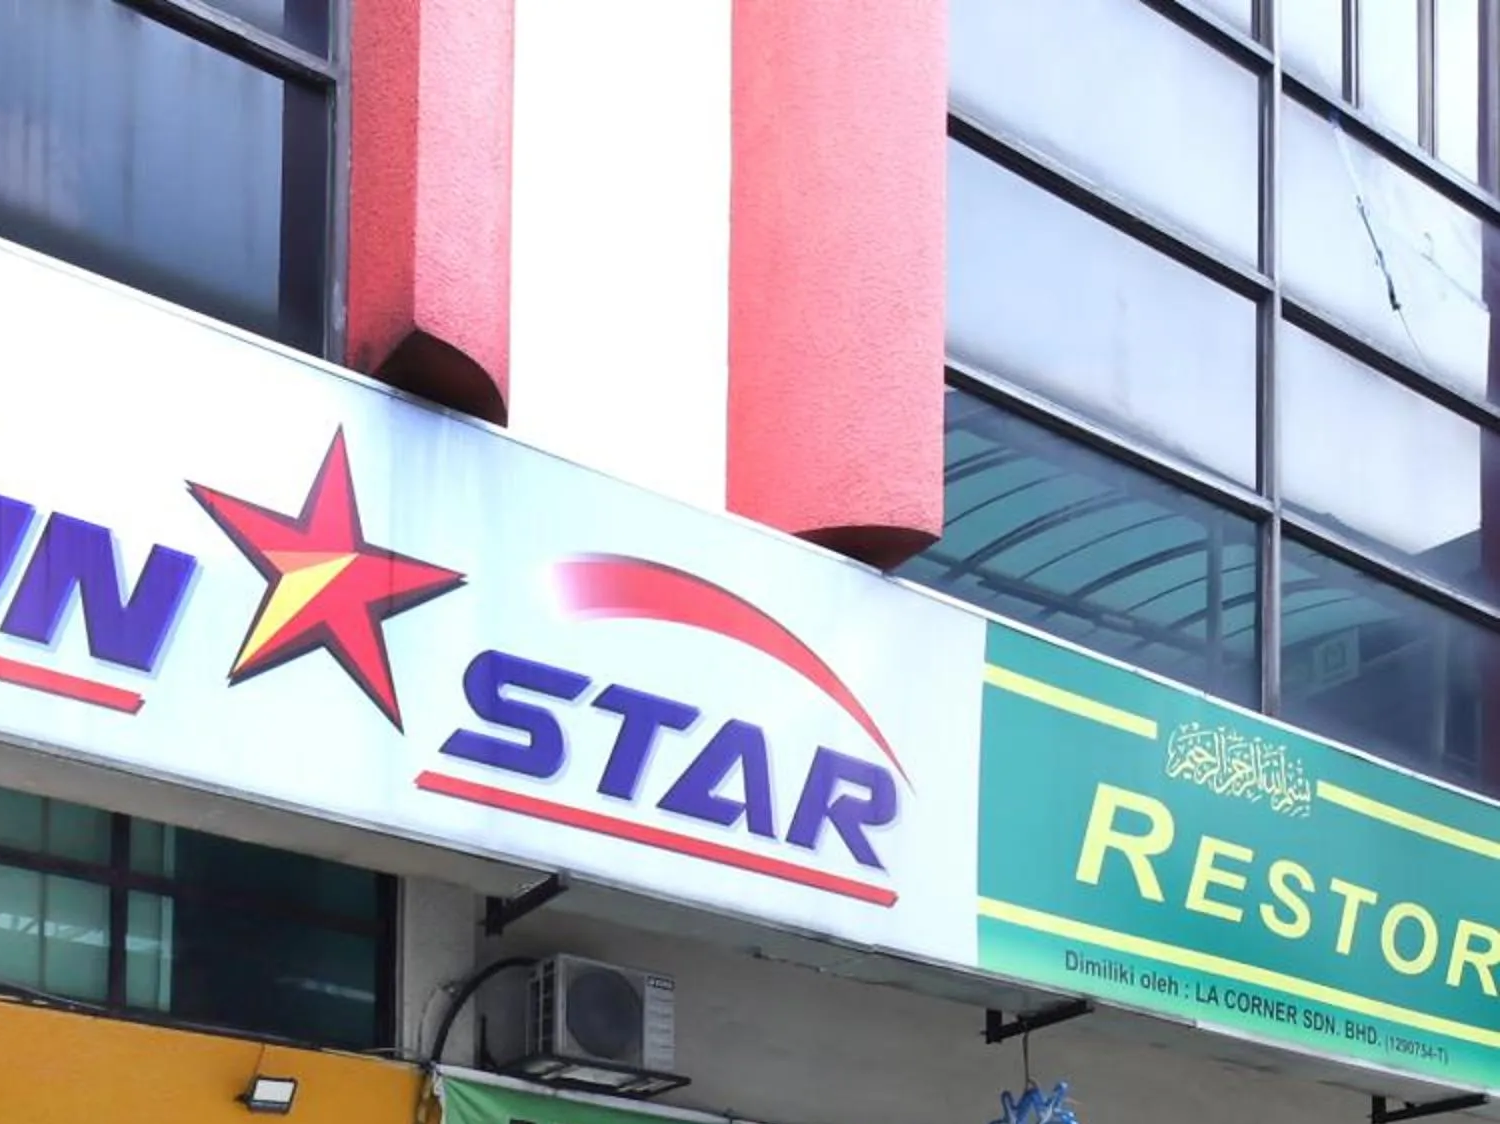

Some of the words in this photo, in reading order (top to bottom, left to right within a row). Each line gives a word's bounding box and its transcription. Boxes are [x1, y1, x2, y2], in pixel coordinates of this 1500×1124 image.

[438, 649, 902, 873] STAR
[1065, 949, 1135, 986] Dimiliki
[1140, 970, 1179, 998] oleh
[1195, 981, 1219, 1008] LA
[1224, 990, 1297, 1026] CORNER
[1303, 1008, 1340, 1036] SDN.
[1345, 1020, 1381, 1047] BHD.
